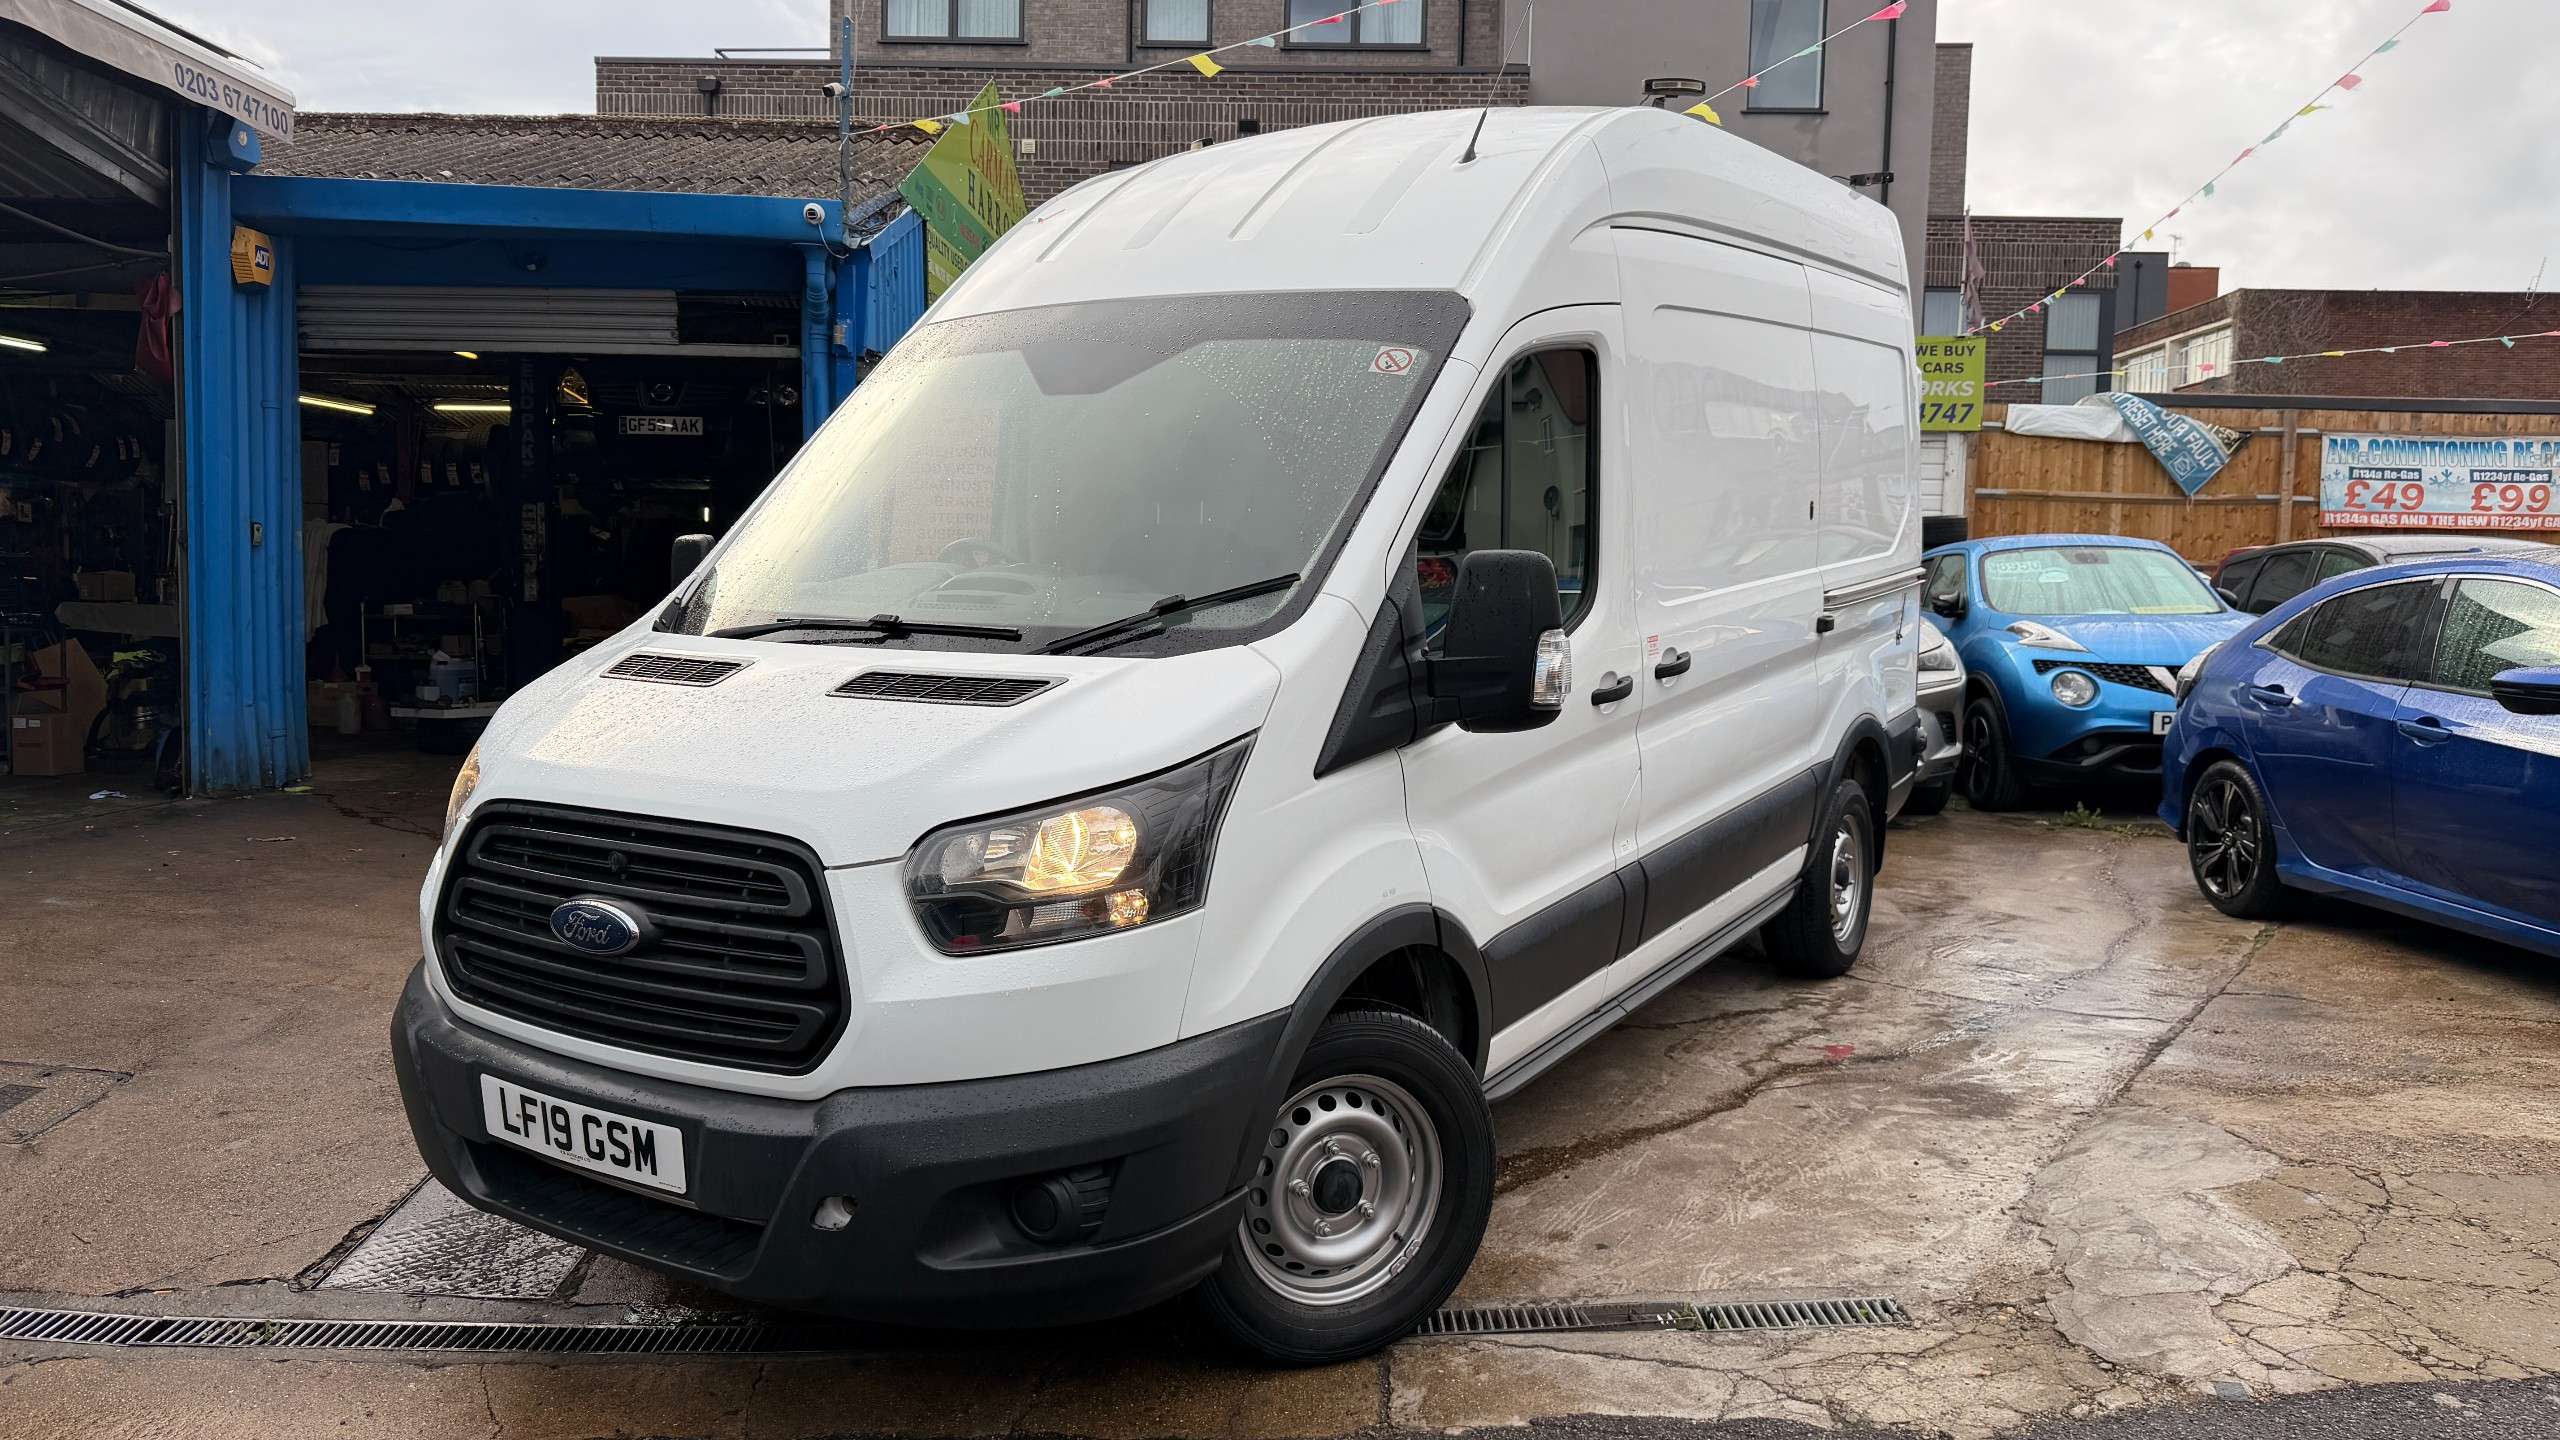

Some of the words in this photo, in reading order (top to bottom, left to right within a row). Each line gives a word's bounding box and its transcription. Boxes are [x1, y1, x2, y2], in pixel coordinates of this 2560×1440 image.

[174, 62, 219, 102] 0203
[222, 84, 288, 135] 6747100
[968, 168, 1014, 237] HARRO
[255, 249, 270, 267] ADT
[1944, 345, 1976, 357] BUY
[1923, 362, 1964, 373] CARS
[671, 418, 700, 433] AAK
[2120, 398, 2158, 431] RESET
[2144, 425, 2178, 456] HERE
[2182, 431, 2221, 470] FAULT
[2344, 480, 2425, 511] £49
[2471, 483, 2551, 513] £99
[2370, 513, 2397, 526] GAS
[2400, 514, 2428, 526] AND
[2431, 515, 2455, 526] THE
[2457, 515, 2488, 527] NEW
[563, 910, 612, 945] Ford
[499, 1086, 573, 1152] LF19
[581, 1113, 658, 1177] GSM
